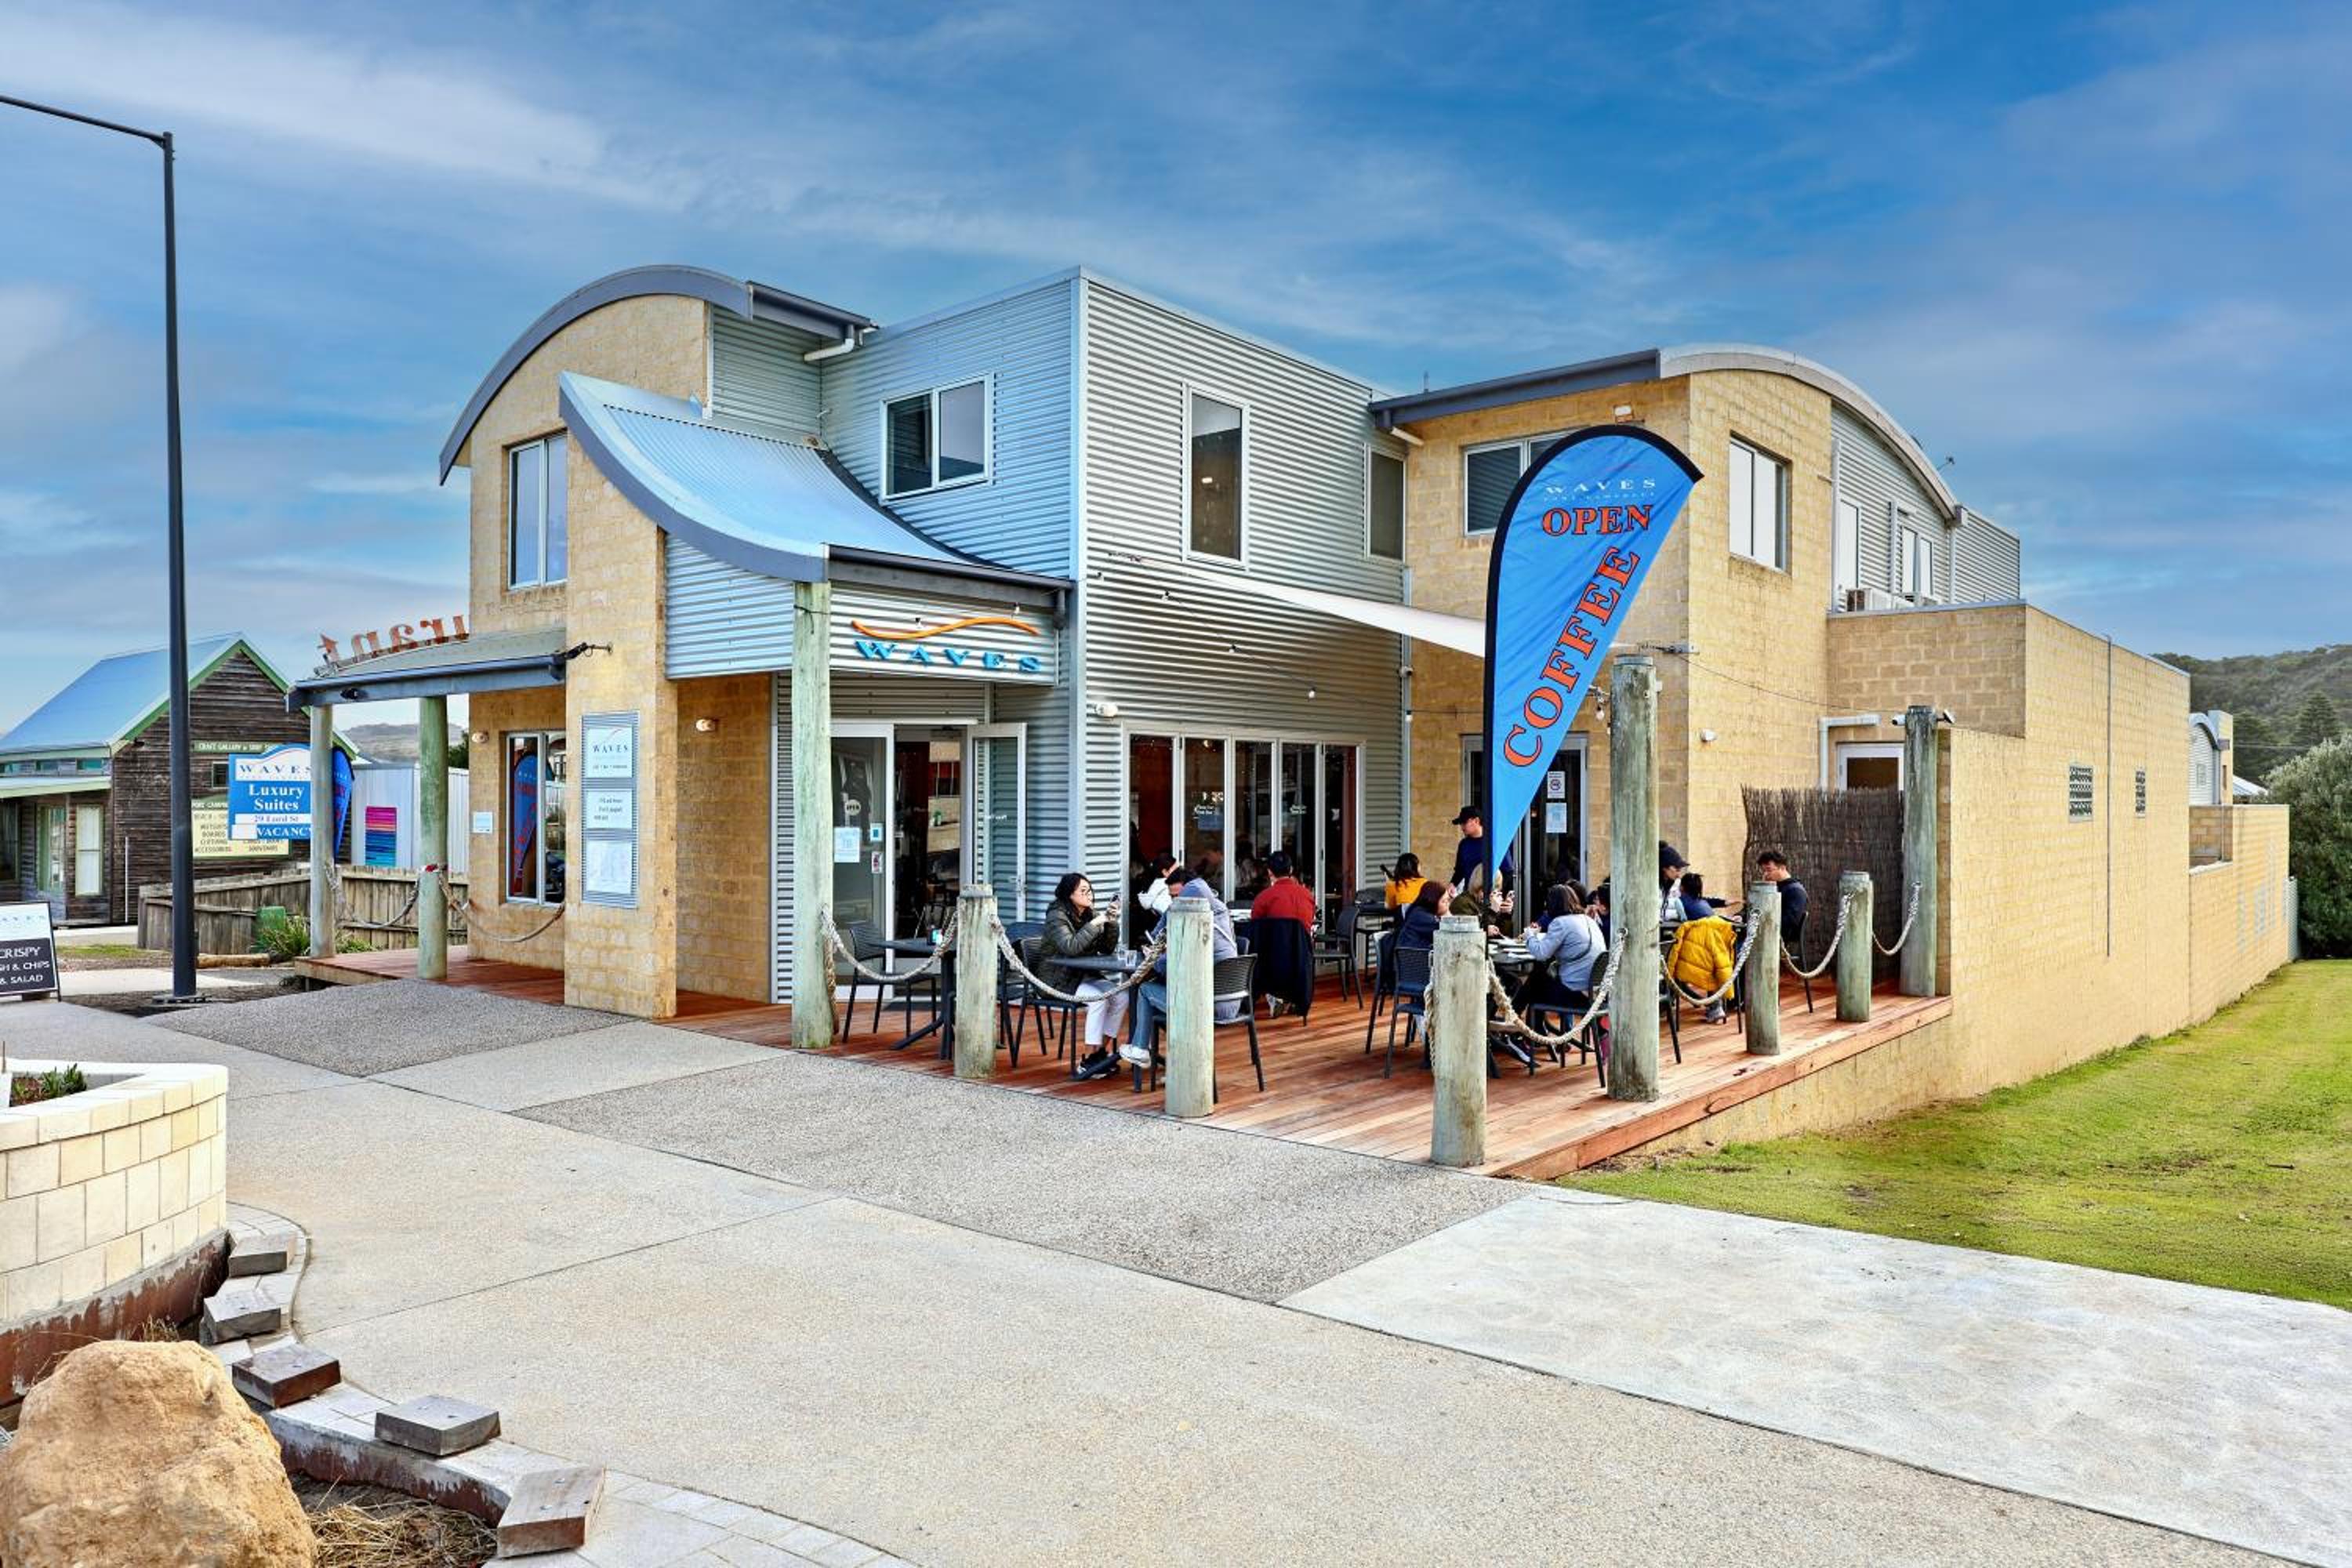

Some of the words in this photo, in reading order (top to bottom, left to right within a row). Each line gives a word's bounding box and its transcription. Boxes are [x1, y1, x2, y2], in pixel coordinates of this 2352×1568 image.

[1545, 478, 1655, 494] WAVES
[1542, 505, 1653, 536] OPEN
[855, 640, 1042, 672] WAVES
[1503, 546, 1640, 767] COFFEE
[249, 784, 304, 799] Luxury
[254, 798, 299, 811] Suites
[23, 960, 50, 970] CHIPS
[10, 975, 43, 983] SALAD
